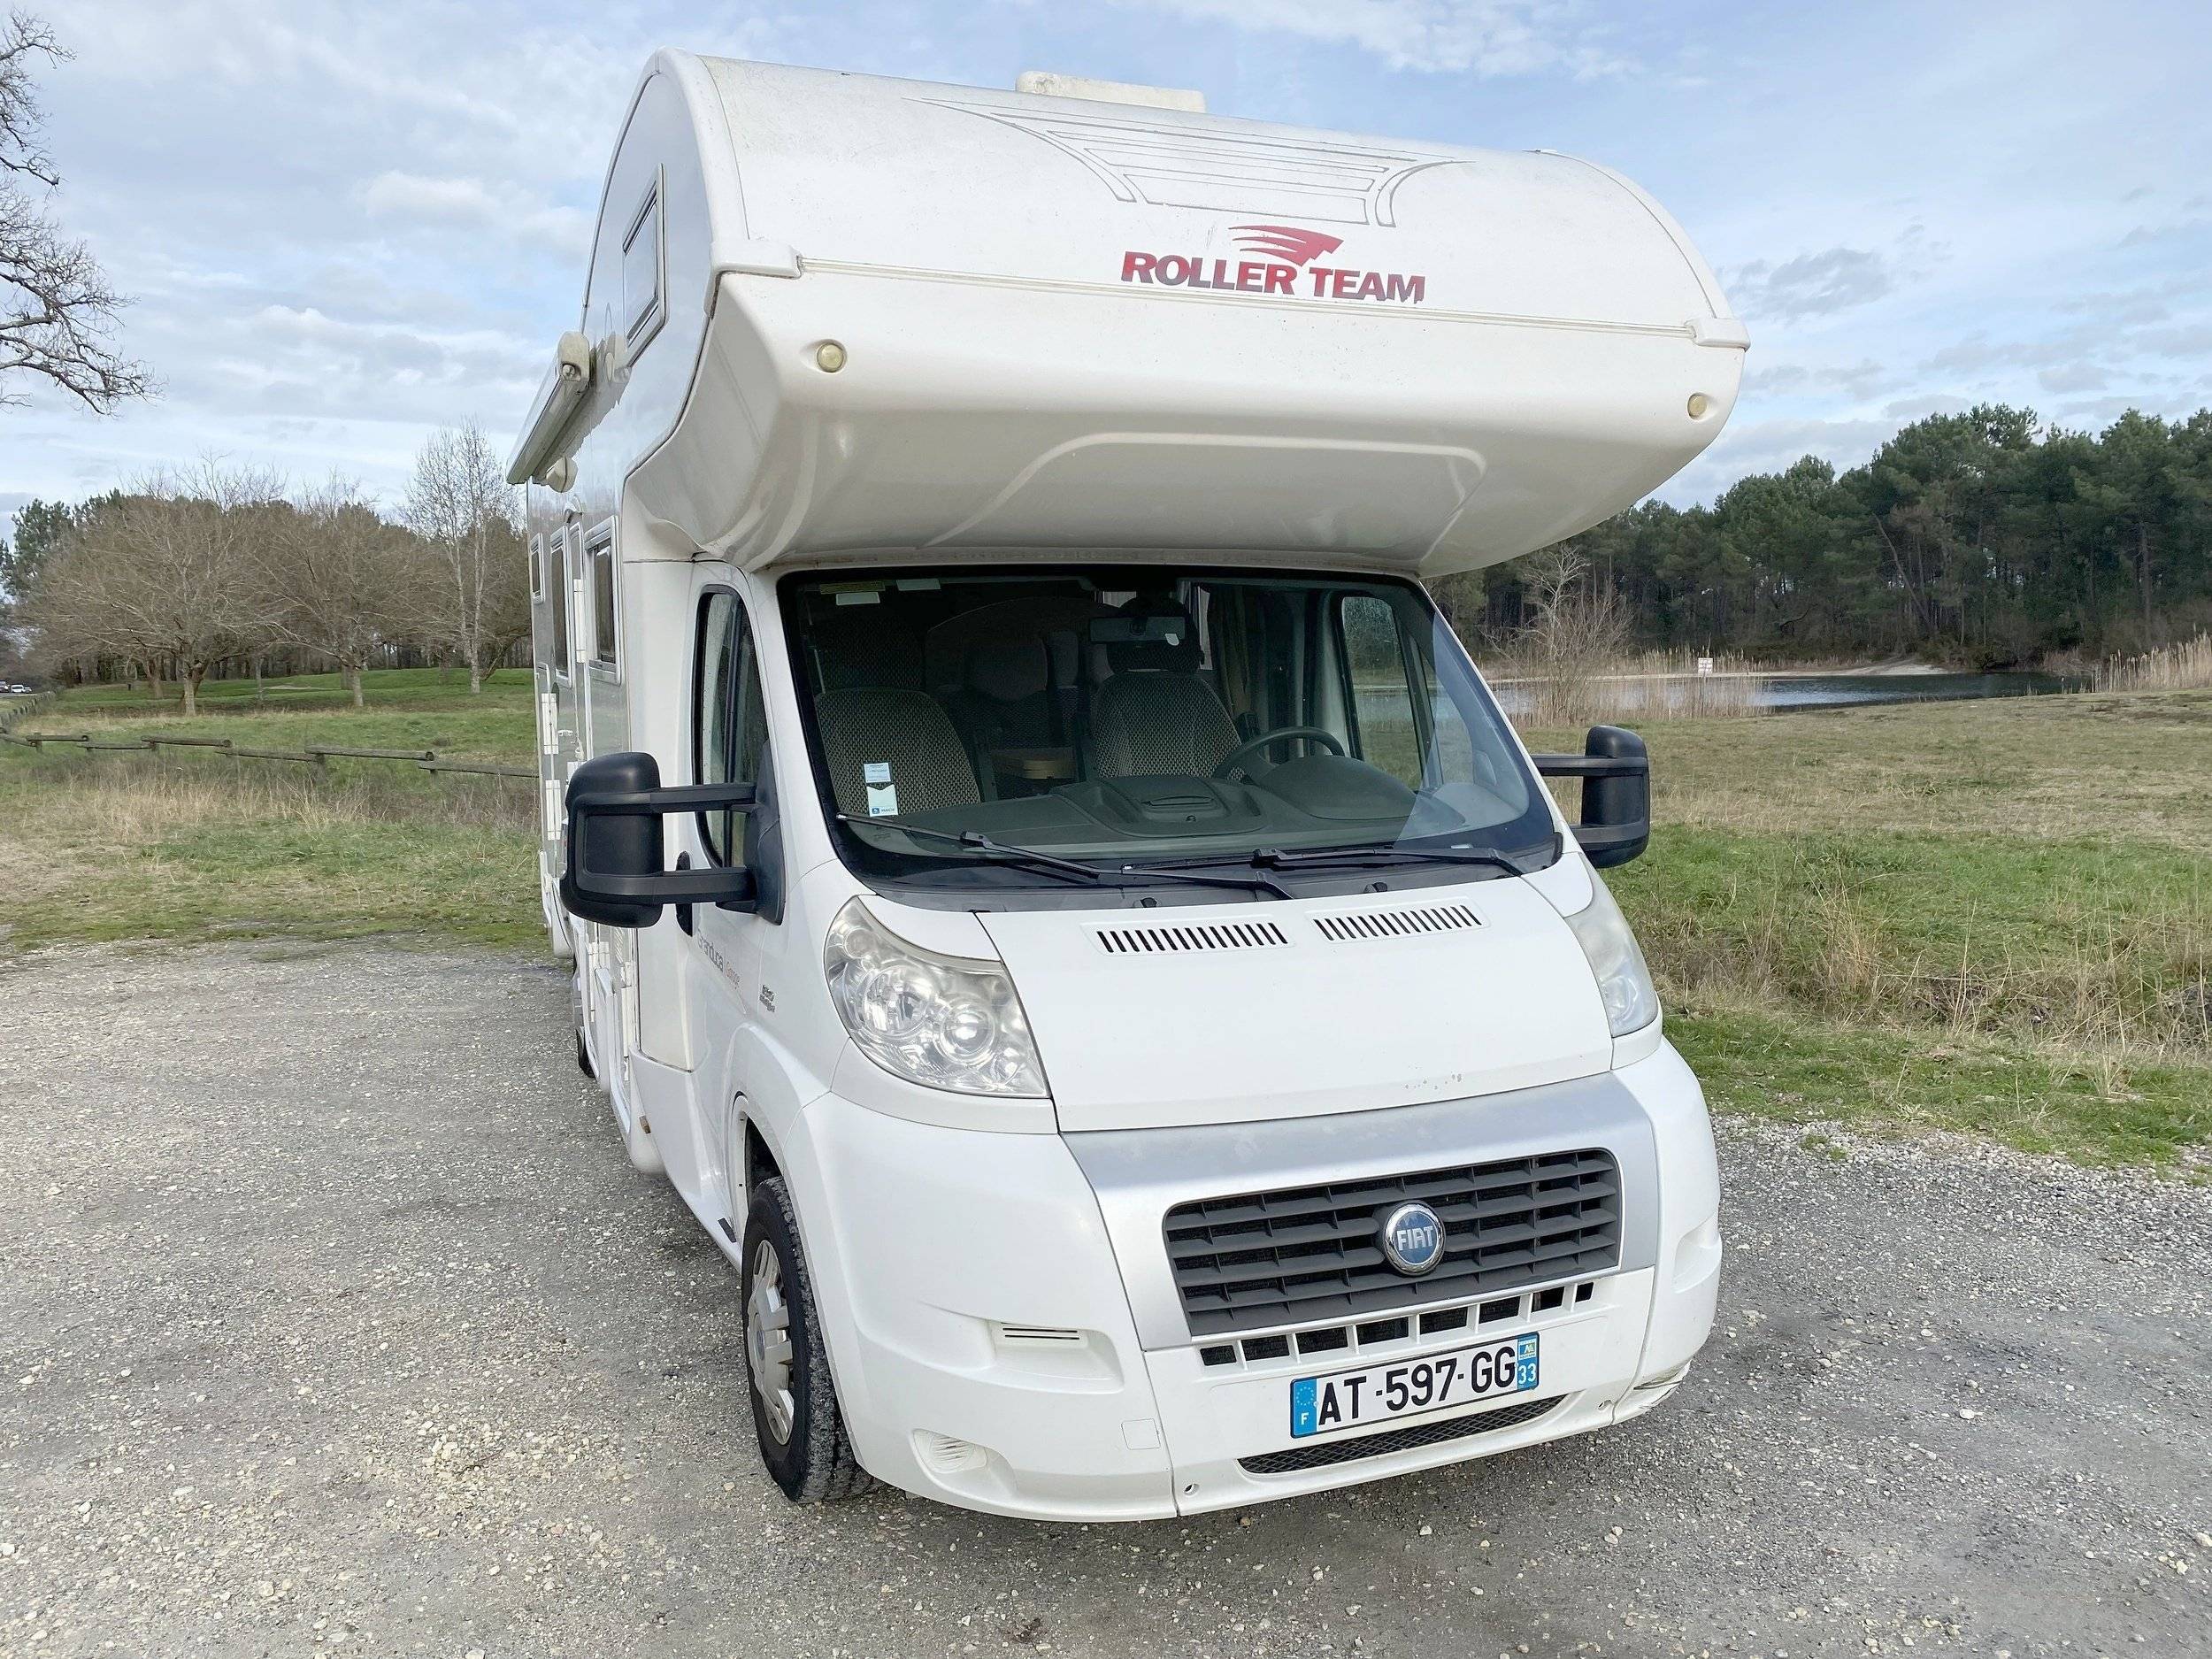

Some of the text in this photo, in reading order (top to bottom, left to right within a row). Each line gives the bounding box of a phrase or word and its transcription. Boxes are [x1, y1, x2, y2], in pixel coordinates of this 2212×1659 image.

[1121, 251, 1425, 303] ROLLER TEAM
[1396, 1225, 1433, 1251] FIAT
[1518, 1363, 1537, 1385] 33
[1301, 1412, 1310, 1425] F
